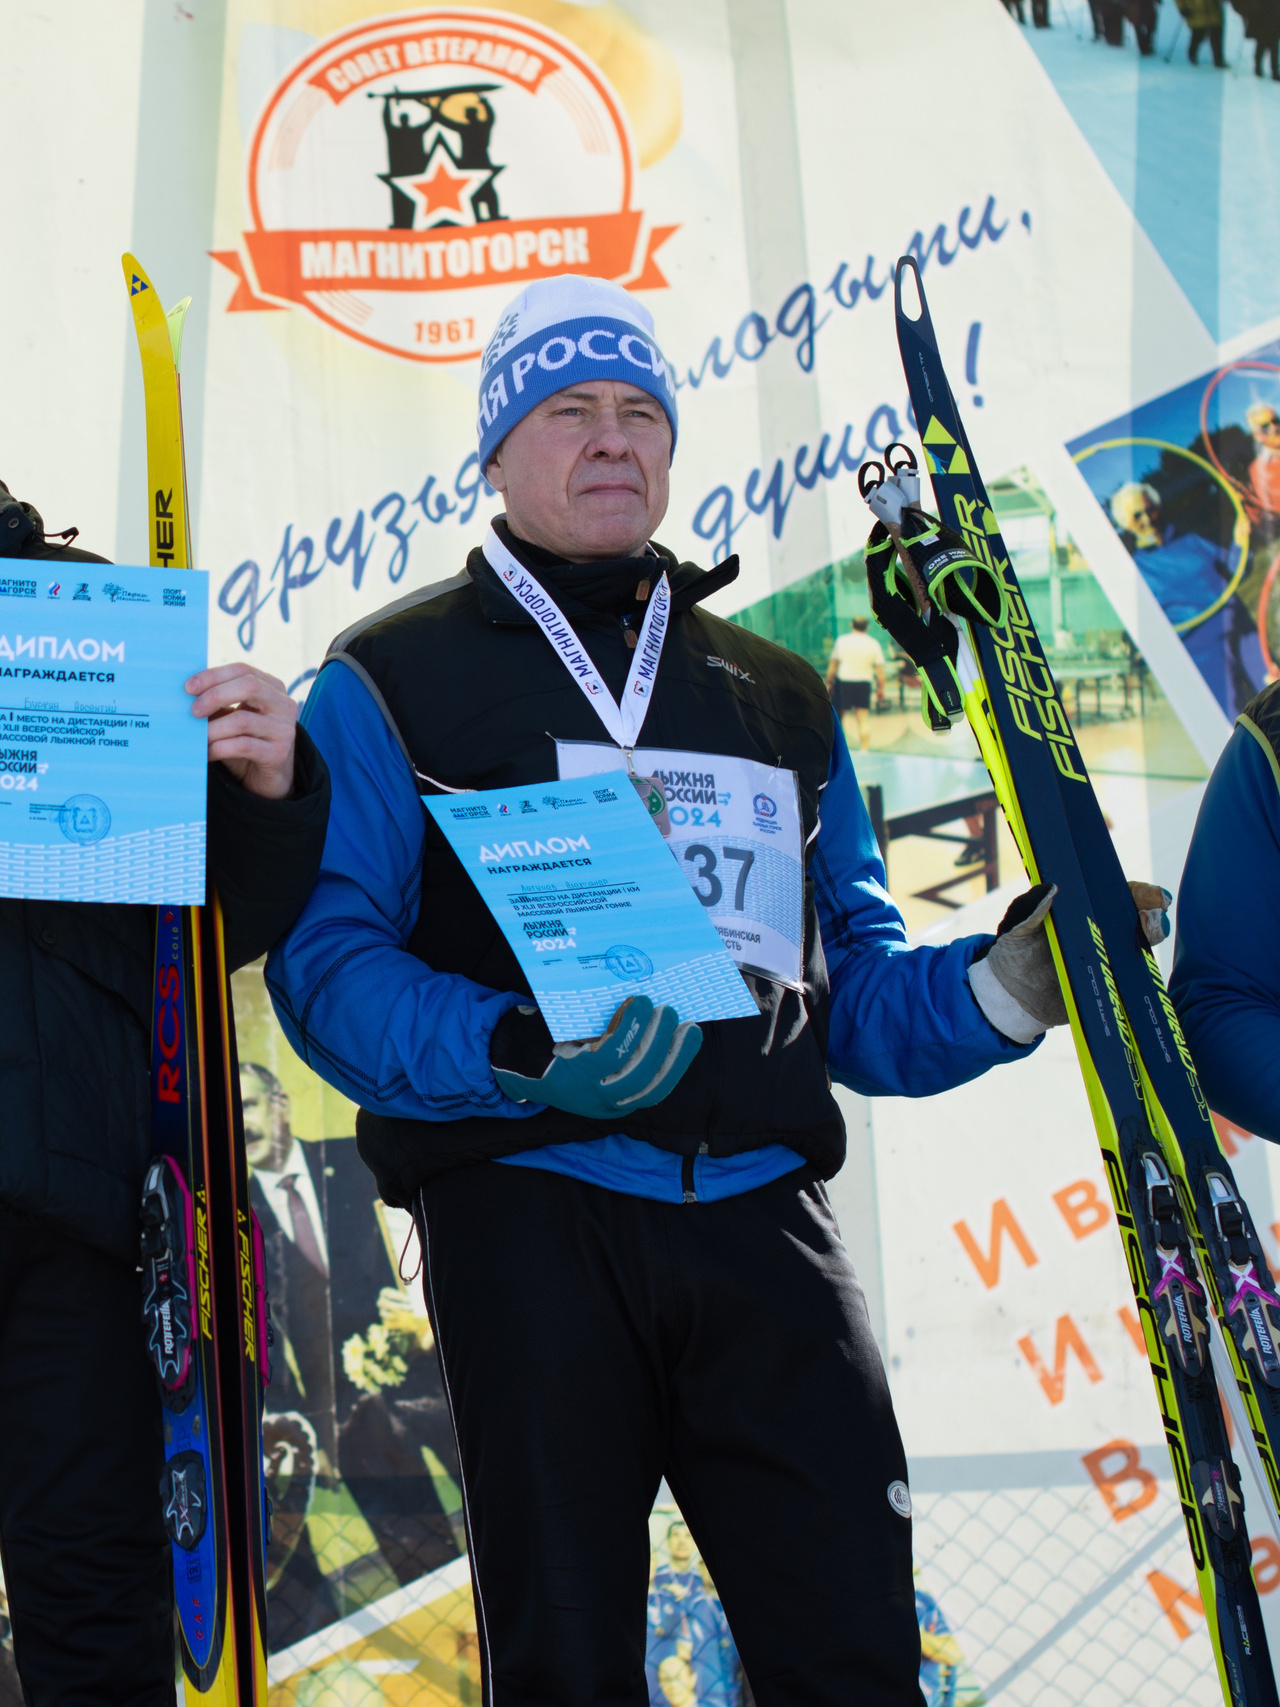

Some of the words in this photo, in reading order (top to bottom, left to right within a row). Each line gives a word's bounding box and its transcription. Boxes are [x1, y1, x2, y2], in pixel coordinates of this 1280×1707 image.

[326, 44, 401, 92] СОВЕТ
[403, 36, 544, 83] ВЕТЕРАНОВ
[300, 227, 589, 280] МАГНИТОГОРСК
[413, 318, 475, 344] 1967
[7, 586, 37, 595] ГОРСК
[513, 575, 594, 678] МАГНИТОГОРСК
[638, 583, 669, 680] МАГНИТОГОРСК
[17, 715, 49, 724] МЕСТО
[52, 716, 66, 725] НА
[68, 717, 127, 728] ДИСТАНЦИИ
[22, 725, 105, 736] ВСЕРОССИЙСКОЙ
[50, 736, 97, 746] ЛЫЖНОЙ
[99, 738, 129, 747] ГОНКЕ
[665, 787, 717, 806] ОССИИ
[450, 805, 487, 814] МАГНИТО
[464, 810, 490, 818] ГОРСК
[669, 806, 722, 827] 024
[479, 835, 591, 863] ДИПЛОМ
[487, 858, 592, 875] НАГРАЖДАЕТСЯ
[571, 888, 622, 900] ДИСТАНЦИИ
[517, 908, 564, 917] МАССОВОЙ
[565, 904, 604, 914] ЛЫЖНОЙ
[605, 901, 632, 910] ГОНКЕ
[538, 897, 608, 909] ВСЕРОССИЙСКОЙ
[523, 919, 564, 931] ЛЫЖНЯ
[526, 928, 569, 939] РОССИИ
[531, 937, 577, 952] 2024
[157, 963, 181, 1104] RCS
[196, 1207, 213, 1341] FISCHER
[238, 1229, 255, 1362] FISCHER
[192, 1598, 205, 1640] CAP
